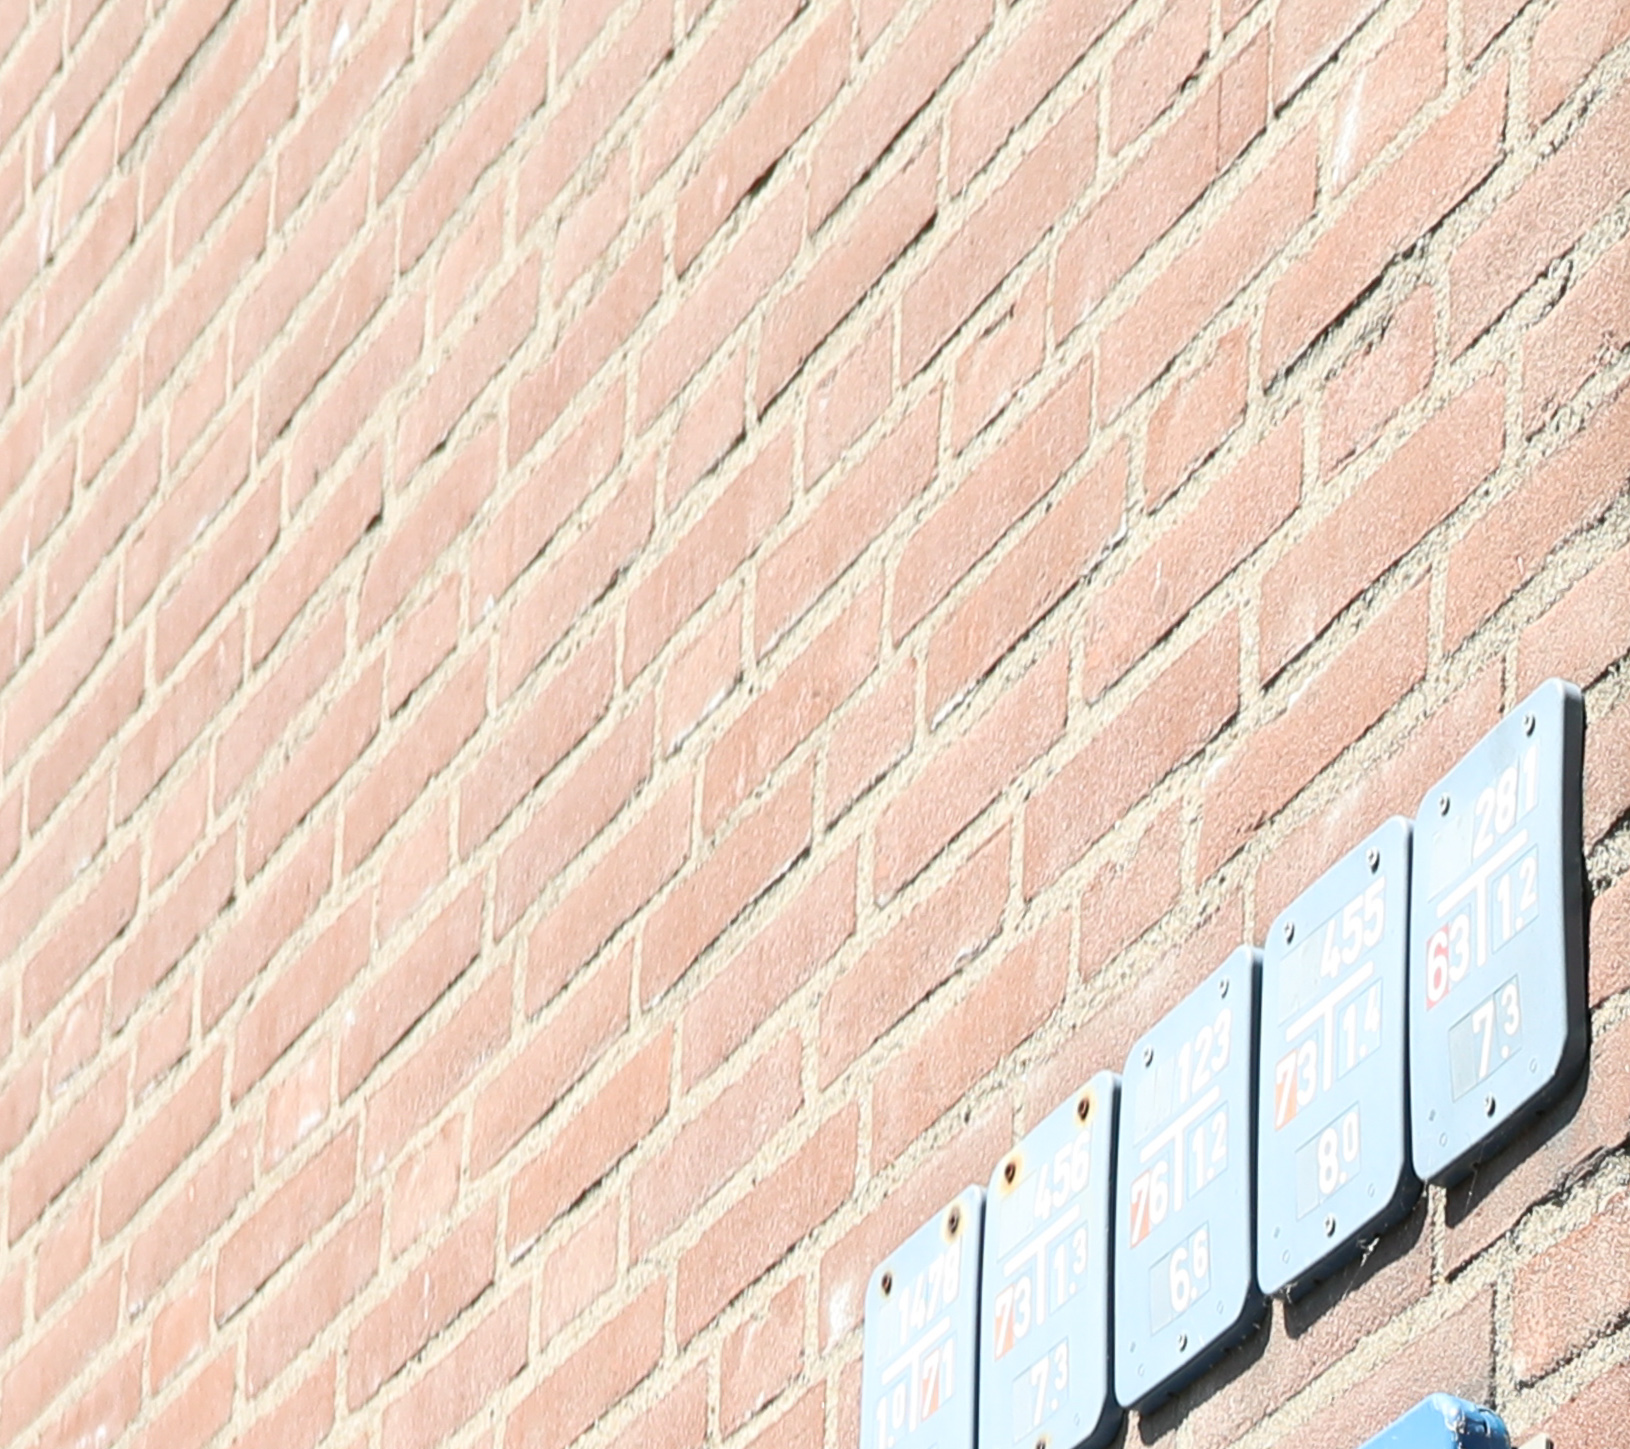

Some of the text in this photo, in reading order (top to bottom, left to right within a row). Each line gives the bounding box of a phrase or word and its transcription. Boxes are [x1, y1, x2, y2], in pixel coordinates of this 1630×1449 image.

[1472, 745, 1537, 858] 281
[1319, 880, 1384, 977] 455
[1427, 915, 1469, 1003] 63
[1178, 1008, 1231, 1102] 123
[1276, 1040, 1316, 1125] 73
[1034, 1133, 1089, 1219] 456
[1131, 1161, 1168, 1244] 76
[898, 1243, 960, 1345] 1478
[994, 1277, 1031, 1358] 73
[922, 1339, 954, 1417] 71
